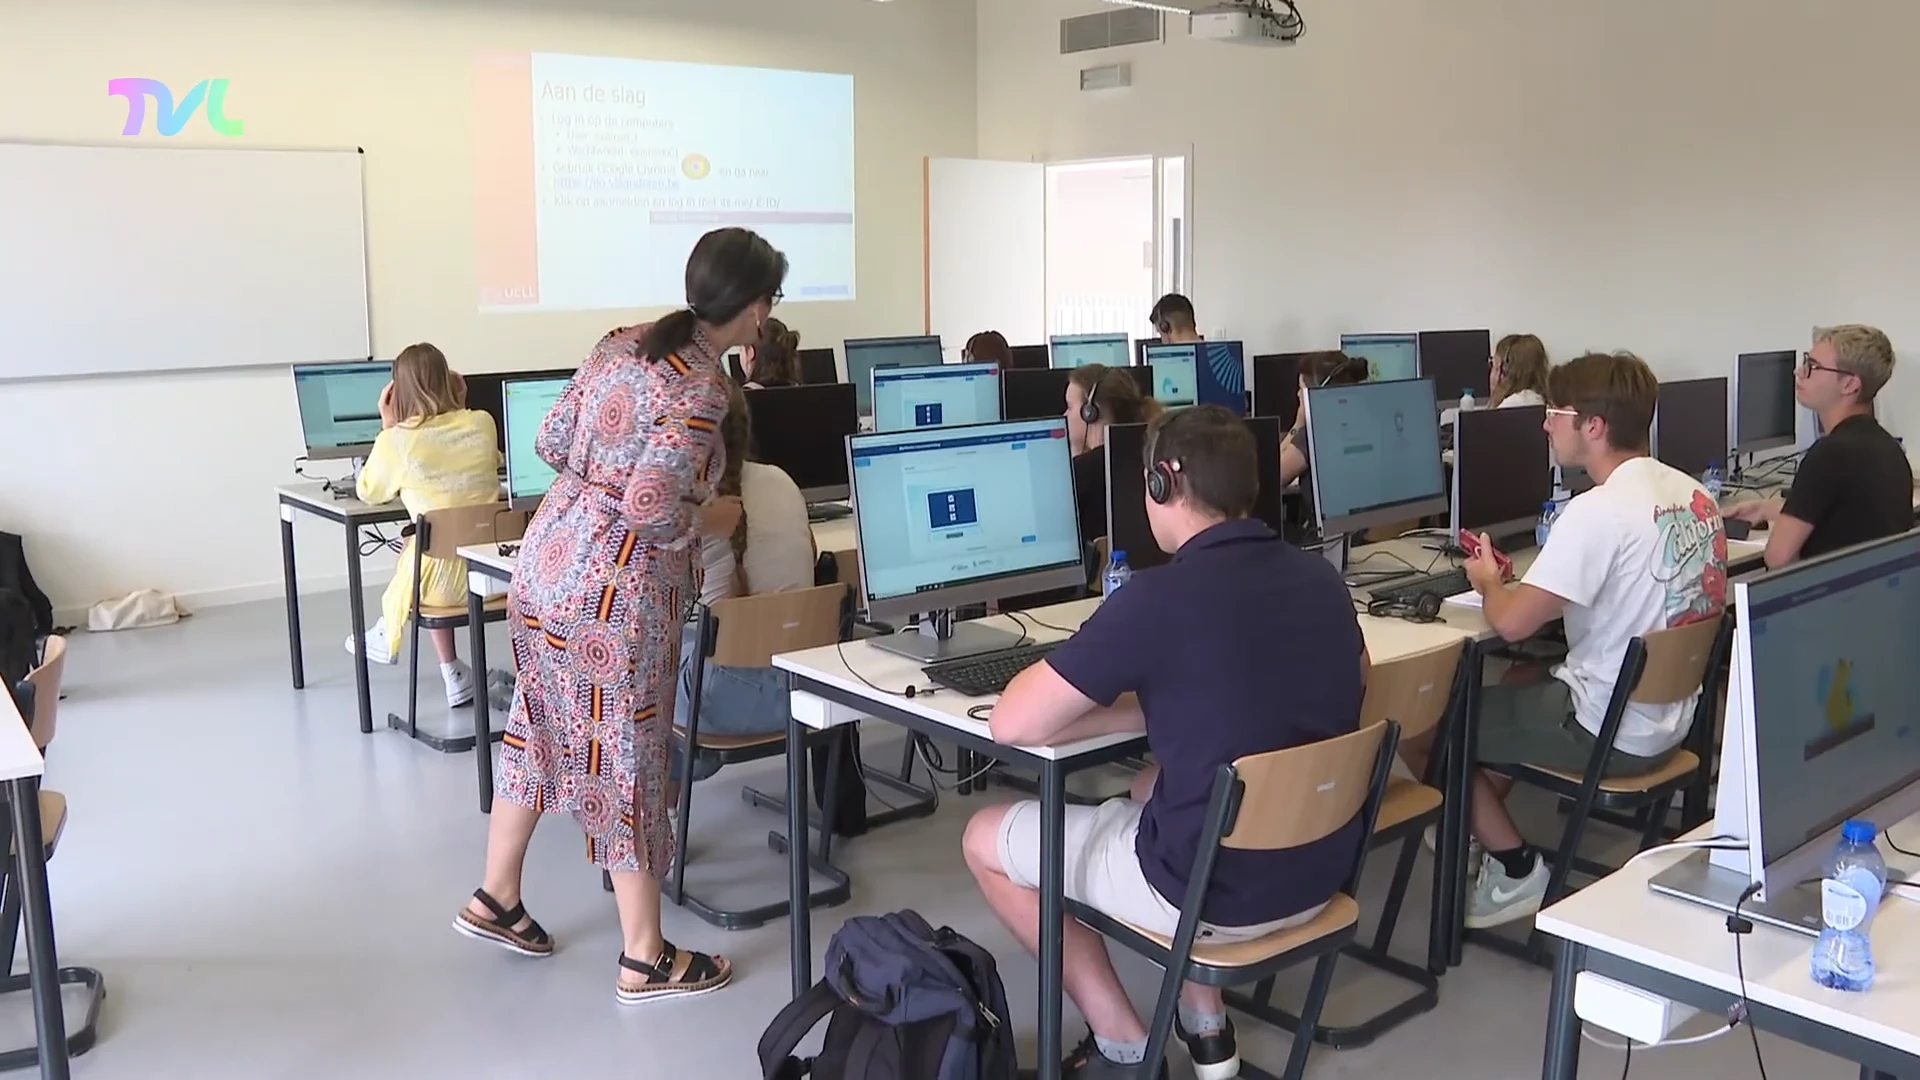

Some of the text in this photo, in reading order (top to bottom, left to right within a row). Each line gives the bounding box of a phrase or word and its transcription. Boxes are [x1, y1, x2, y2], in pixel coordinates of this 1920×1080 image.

[541, 81, 646, 109] Aan de slag
